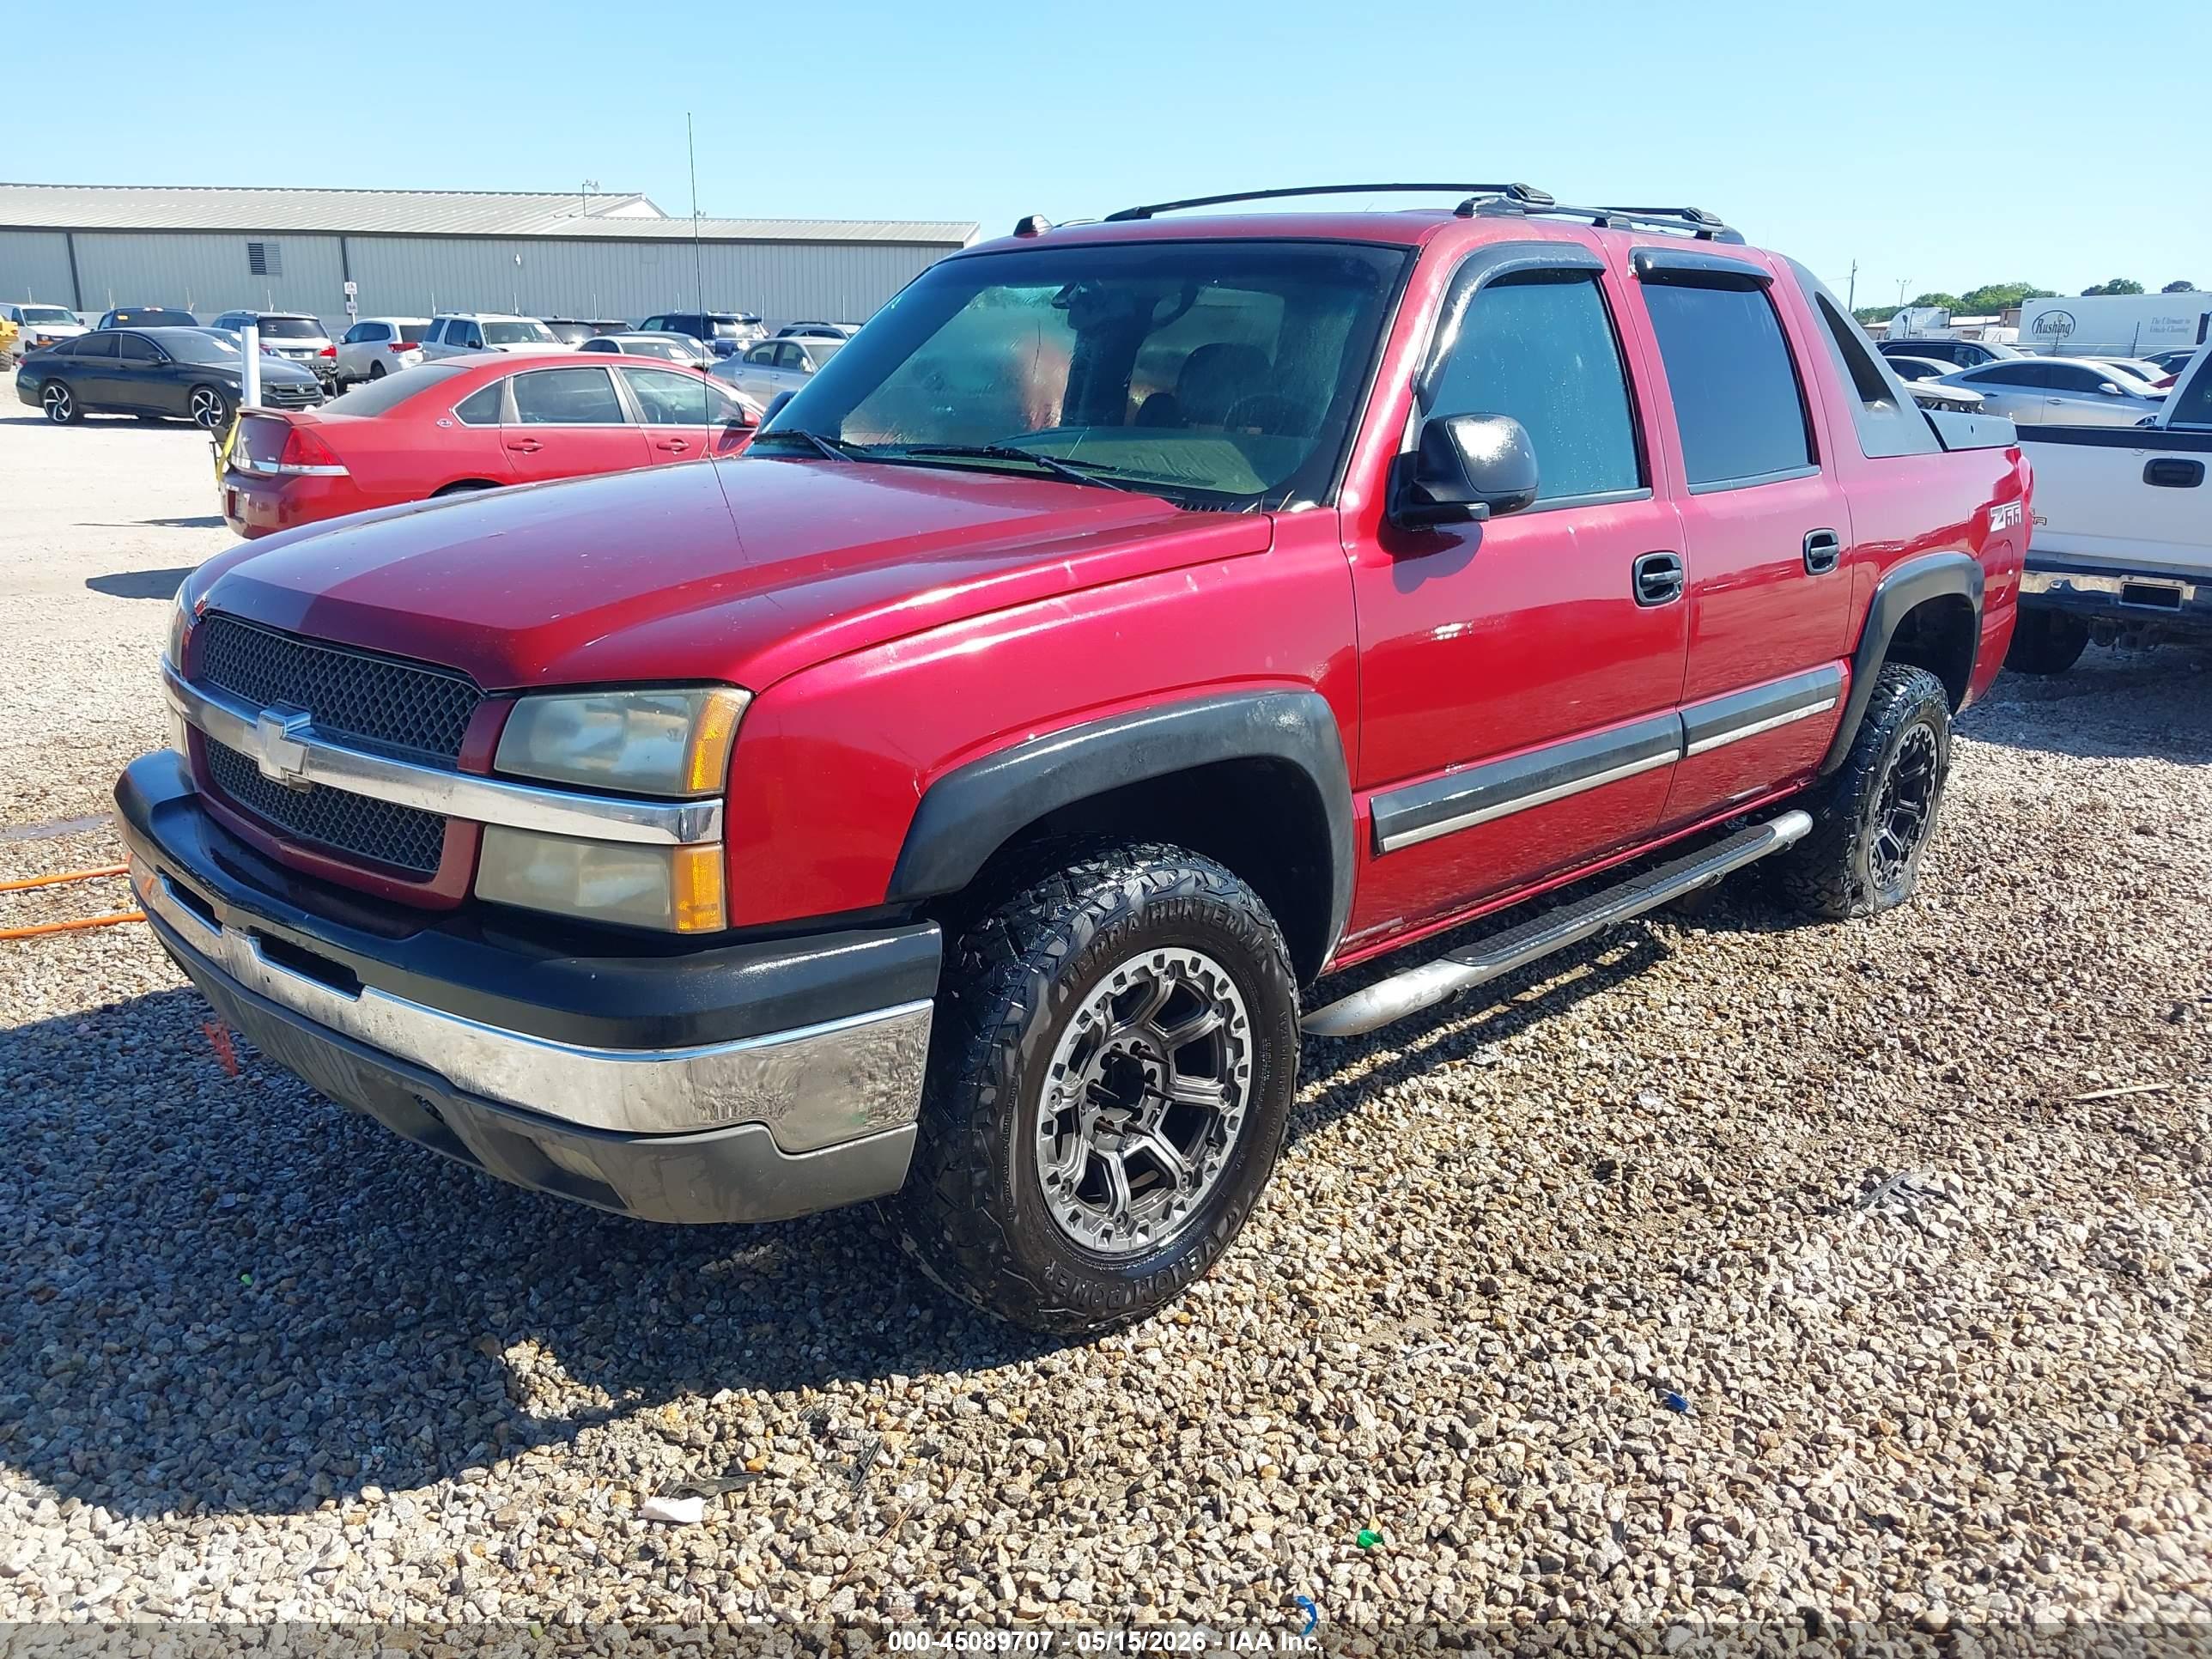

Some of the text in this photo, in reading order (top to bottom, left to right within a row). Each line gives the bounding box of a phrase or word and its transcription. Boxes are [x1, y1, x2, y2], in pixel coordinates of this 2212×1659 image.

[2035, 318, 2071, 337] Rushing
[1060, 910, 1141, 989] TERRA
[1146, 896, 1240, 936] HUNTER
[1043, 1258, 1126, 1310] POWER
[1133, 1230, 1223, 1305] VENOM
